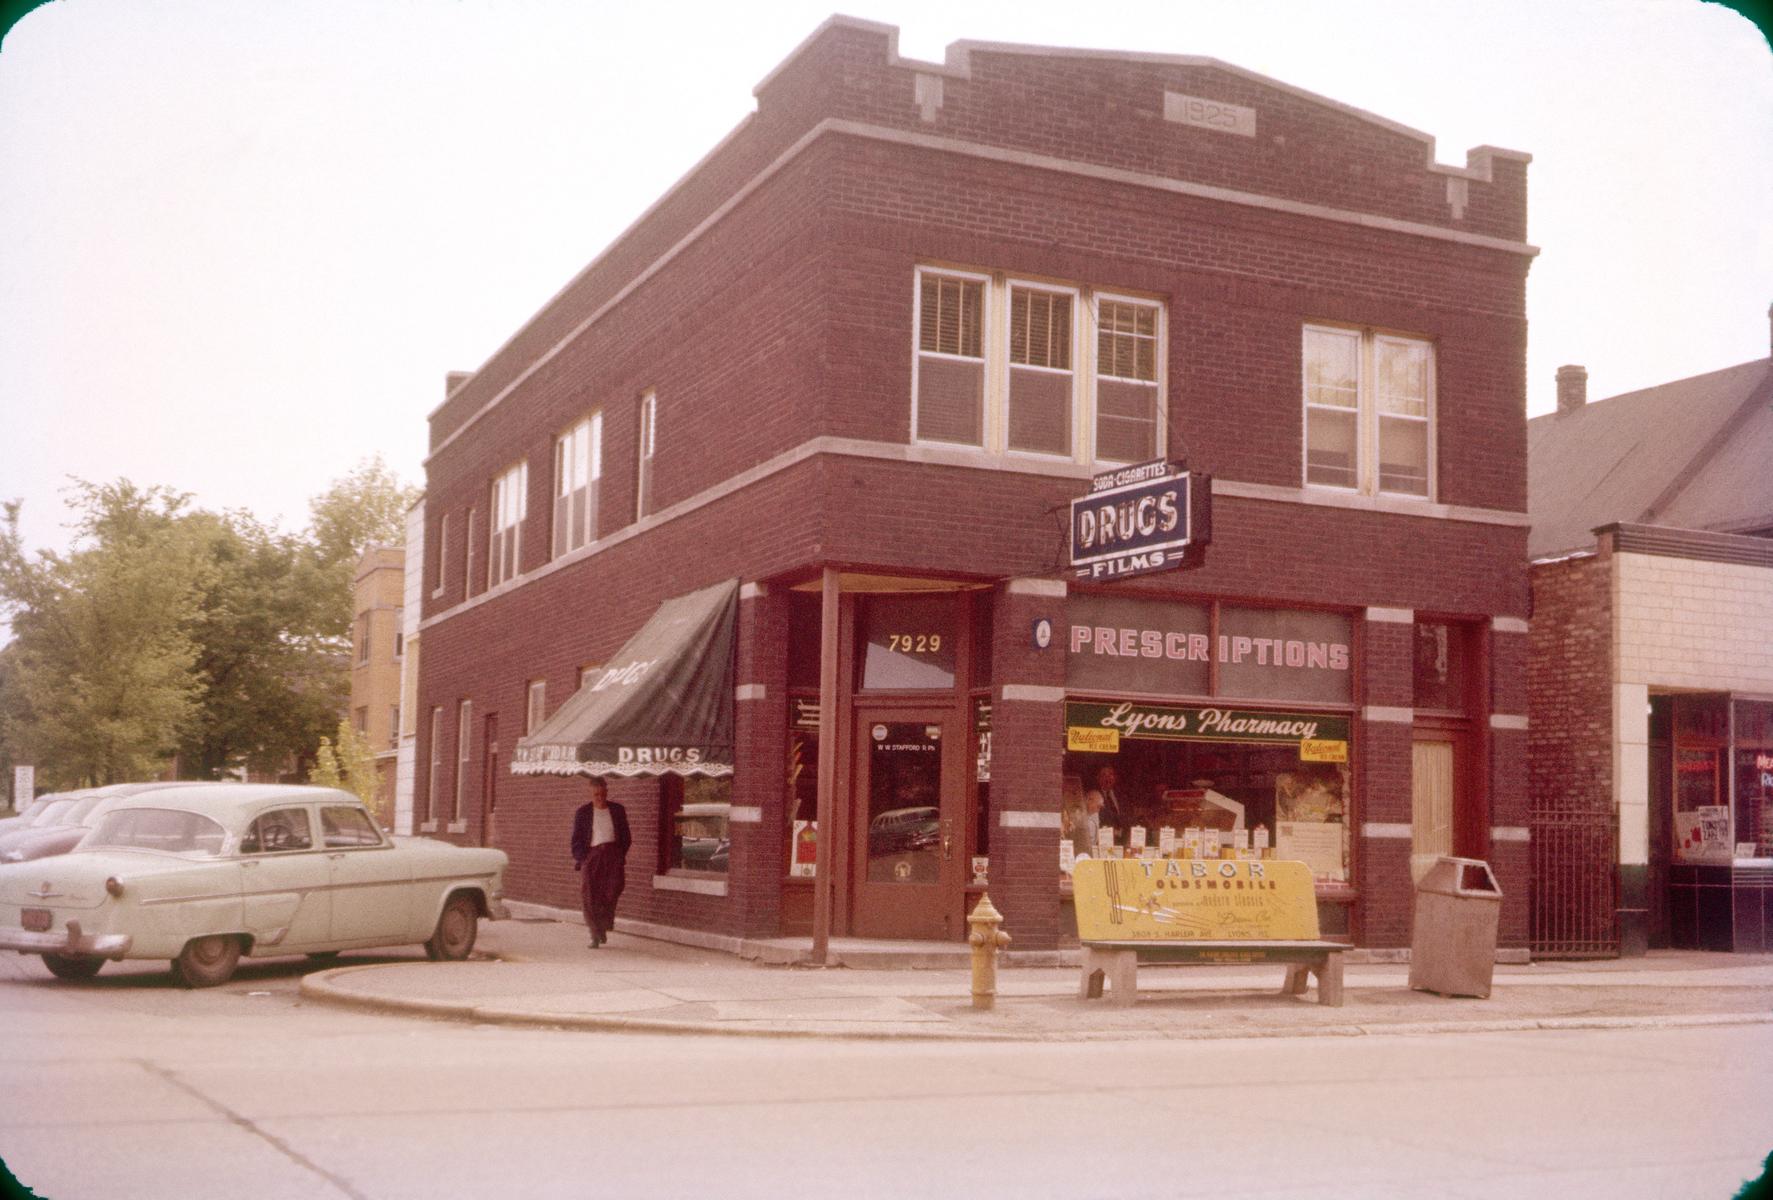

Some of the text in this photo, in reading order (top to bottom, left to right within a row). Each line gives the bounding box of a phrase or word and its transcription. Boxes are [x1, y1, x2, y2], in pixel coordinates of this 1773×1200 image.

[1183, 101, 1237, 128] 1925
[1078, 490, 1178, 550] DRUGS
[1092, 551, 1165, 578] FILMS
[888, 634, 941, 653] 7929
[1070, 624, 1349, 671] PRESCRIPTIONS
[1100, 702, 1319, 739] Lyons Pharmacy
[618, 747, 701, 763] DRUGS
[892, 744, 921, 752] STAFFORD
[1140, 859, 1266, 880] TABOR
[1156, 879, 1277, 890] OLDSMOBILE
